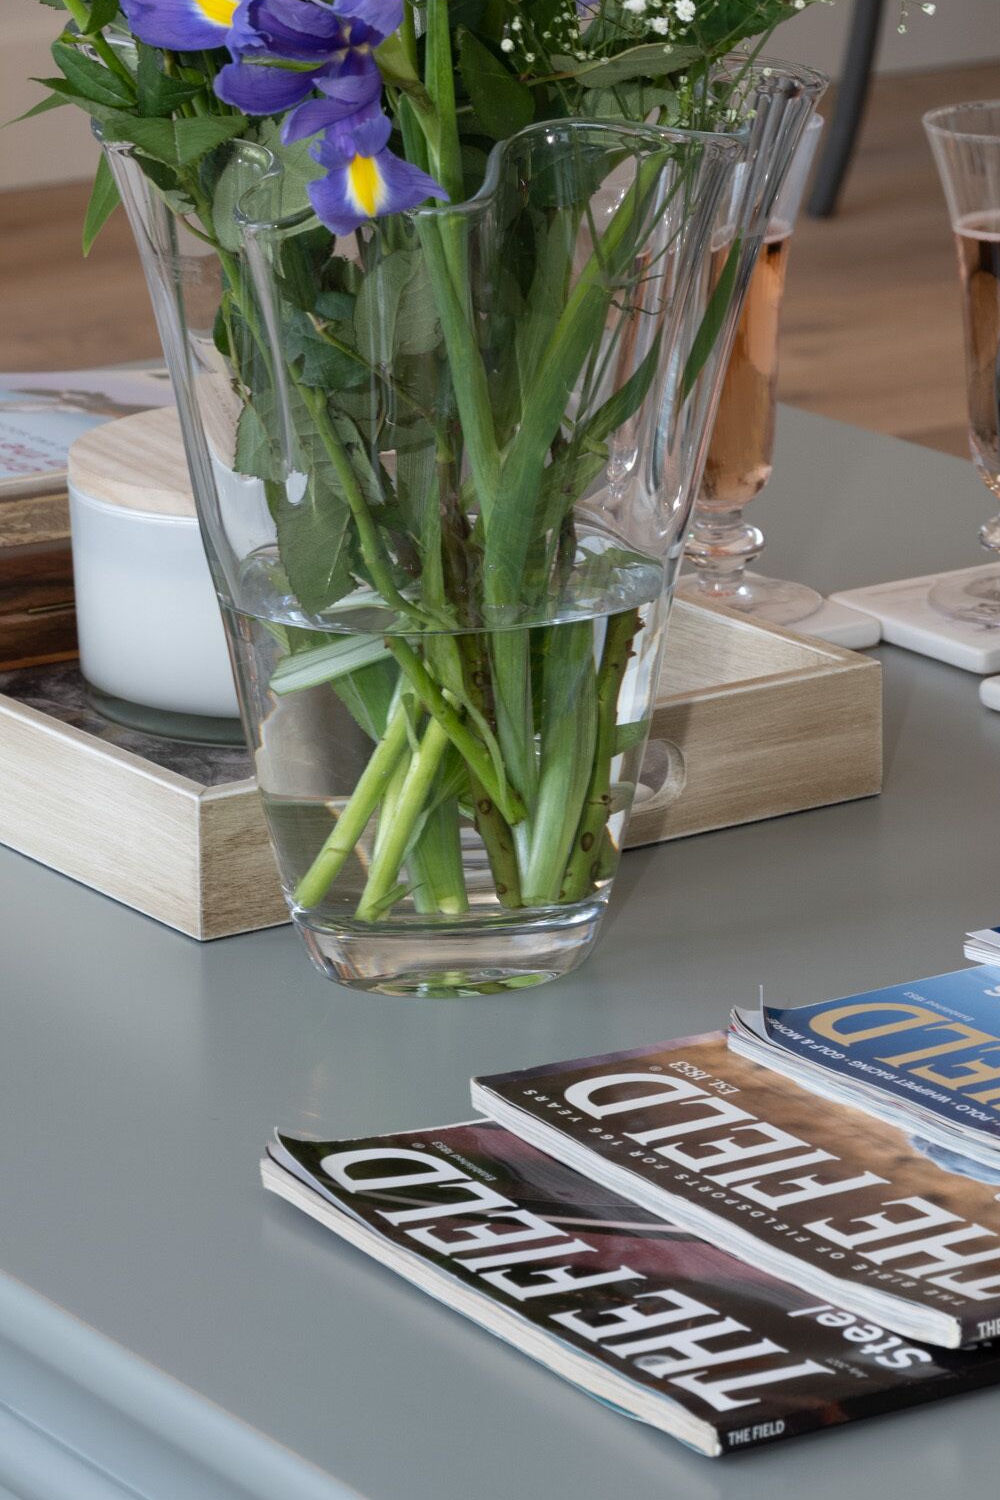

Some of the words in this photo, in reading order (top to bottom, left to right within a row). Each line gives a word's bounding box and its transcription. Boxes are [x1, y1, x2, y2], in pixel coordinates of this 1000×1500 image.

[920, 1000, 975, 1021] Established
[808, 1043, 847, 1058] GOLF
[667, 1060, 713, 1080] 1853
[846, 1060, 899, 1079] RACING
[706, 1078, 741, 1094] Est.
[892, 1078, 954, 1102] WHIPPET
[520, 1089, 584, 1121] YEARS
[953, 1104, 996, 1120] POLO
[559, 1072, 892, 1211] FIELD
[587, 1126, 624, 1145] 166
[429, 1140, 456, 1153] 1853
[448, 1154, 498, 1181] Established
[627, 1149, 670, 1169] FOR
[674, 1173, 811, 1242] FIELDSPORTS
[320, 1148, 647, 1301] FIELD
[813, 1245, 844, 1259] OF
[850, 1263, 916, 1287] BIBLE
[924, 1289, 964, 1305] THE
[786, 1303, 933, 1370] Steel
[547, 1288, 835, 1411] THE
[728, 1427, 751, 1446] THE
[752, 1419, 785, 1441] FIELD
